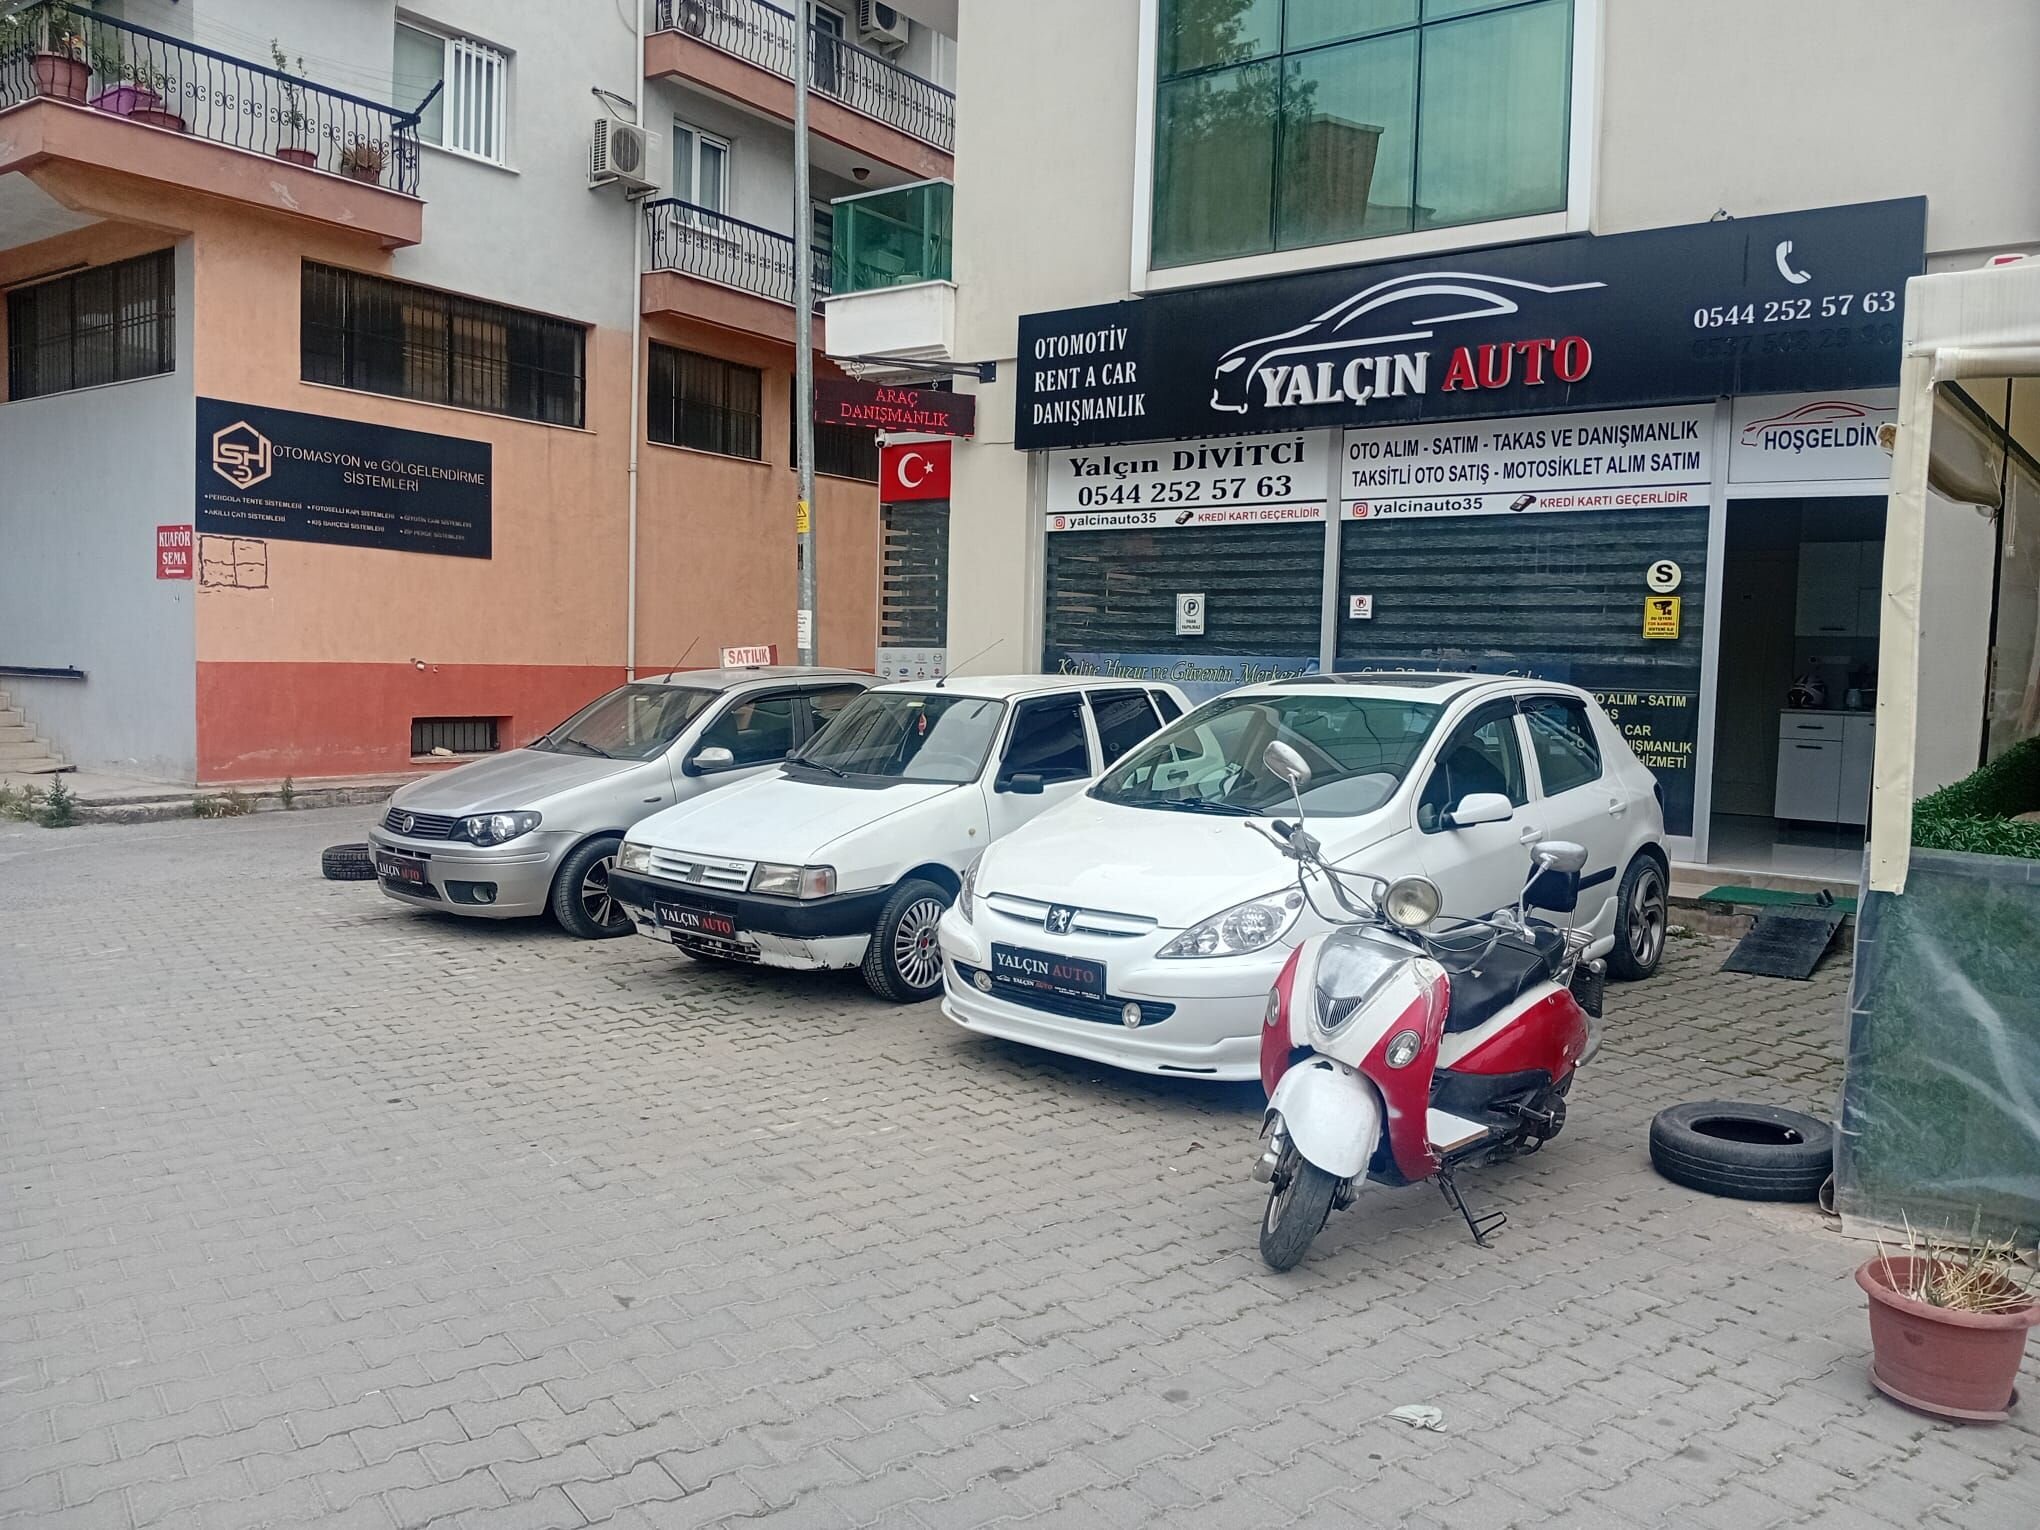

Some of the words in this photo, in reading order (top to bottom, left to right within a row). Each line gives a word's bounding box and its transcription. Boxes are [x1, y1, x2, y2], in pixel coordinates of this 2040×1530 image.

[1693, 303, 1756, 329] 0544
[1763, 298, 1812, 323] 252
[1821, 294, 1854, 318] 57
[1862, 290, 1896, 314] 63
[1034, 324, 1128, 360] OTOMOTİV
[1034, 366, 1080, 394] RENT
[1085, 364, 1098, 388] A
[1101, 361, 1137, 387] CAR
[1258, 350, 1431, 409] YALÇIN
[1441, 335, 1593, 393] AUTO
[876, 388, 918, 408] ARAÇ
[841, 403, 949, 427] DANIŞMANLIK
[1033, 394, 1146, 429] DANIŞMANLIK
[1349, 441, 1380, 461] OTO
[1383, 438, 1419, 459] ALIM
[1432, 434, 1478, 456] SATIM
[1492, 431, 1546, 452] TAKAS
[1551, 428, 1573, 448] VE
[1578, 420, 1699, 449] DANIŞMANLIK
[272, 444, 360, 469] OTOMASYON
[364, 460, 379, 471] ve
[381, 459, 485, 486] GÖLGELENDİRME
[1069, 455, 1159, 480] Yalçın
[1172, 437, 1305, 471] DİVİTCİ
[1352, 464, 1411, 487] TAKSİTLİ
[1415, 464, 1445, 484] OTO
[1448, 463, 1490, 486] SATIŞ
[1502, 455, 1603, 480] MOTOSİKLET
[1606, 454, 1645, 474] ALIM
[1650, 451, 1700, 472] SATIM
[343, 470, 419, 492] SİSTEMLERİ
[1078, 483, 1142, 507] 0544
[1151, 480, 1201, 503] 252
[1211, 478, 1246, 500] 57
[1256, 475, 1292, 498] 63
[1373, 497, 1483, 516] yalcinauto35
[1539, 495, 1575, 508] KREDİ
[1577, 495, 1612, 507] KARTI
[1615, 490, 1688, 508] GEÇERLİDİR
[1069, 512, 1157, 528] yalcinauto35
[1198, 510, 1226, 522] KREDİ
[1228, 510, 1258, 522] KARTI
[1259, 507, 1320, 522] GEÇERLİDİR
[162, 551, 187, 565] SEMA
[1655, 564, 1673, 583] S
[728, 648, 768, 665] SATILIK
[1151, 667, 1168, 680] ve
[1170, 661, 1233, 683] Güvenin
[1607, 693, 1638, 705] ALIM
[1648, 695, 1687, 707] SATIM
[1624, 724, 1651, 736] CAR
[661, 908, 700, 927] YALÇIN
[701, 917, 731, 934] AUTO
[996, 952, 1049, 975] YALÇIN
[1052, 964, 1094, 983] AUTO
